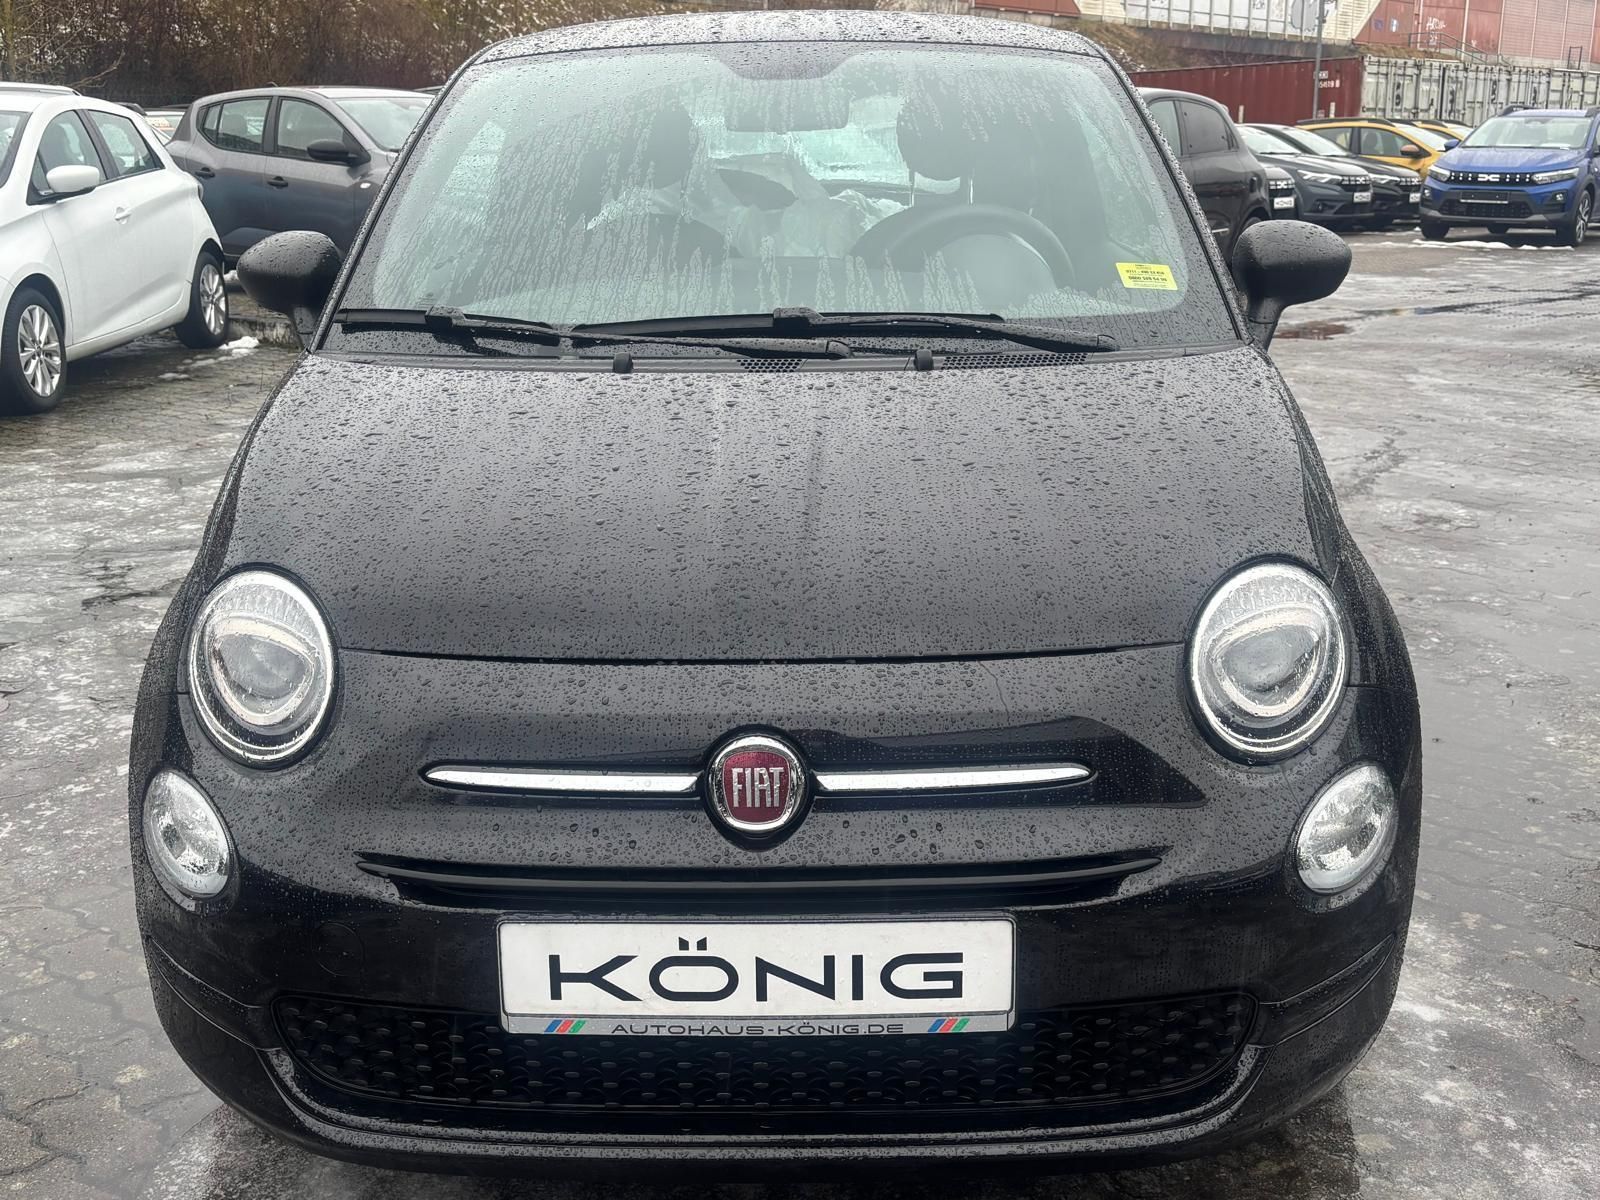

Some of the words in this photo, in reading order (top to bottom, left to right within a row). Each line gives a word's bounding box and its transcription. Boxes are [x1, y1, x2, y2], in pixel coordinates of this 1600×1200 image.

[731, 766, 784, 808] FIAT
[548, 936, 964, 1003] KÖNIG
[610, 1020, 904, 1036] AUTOHAUS-KÖNIG.DE
